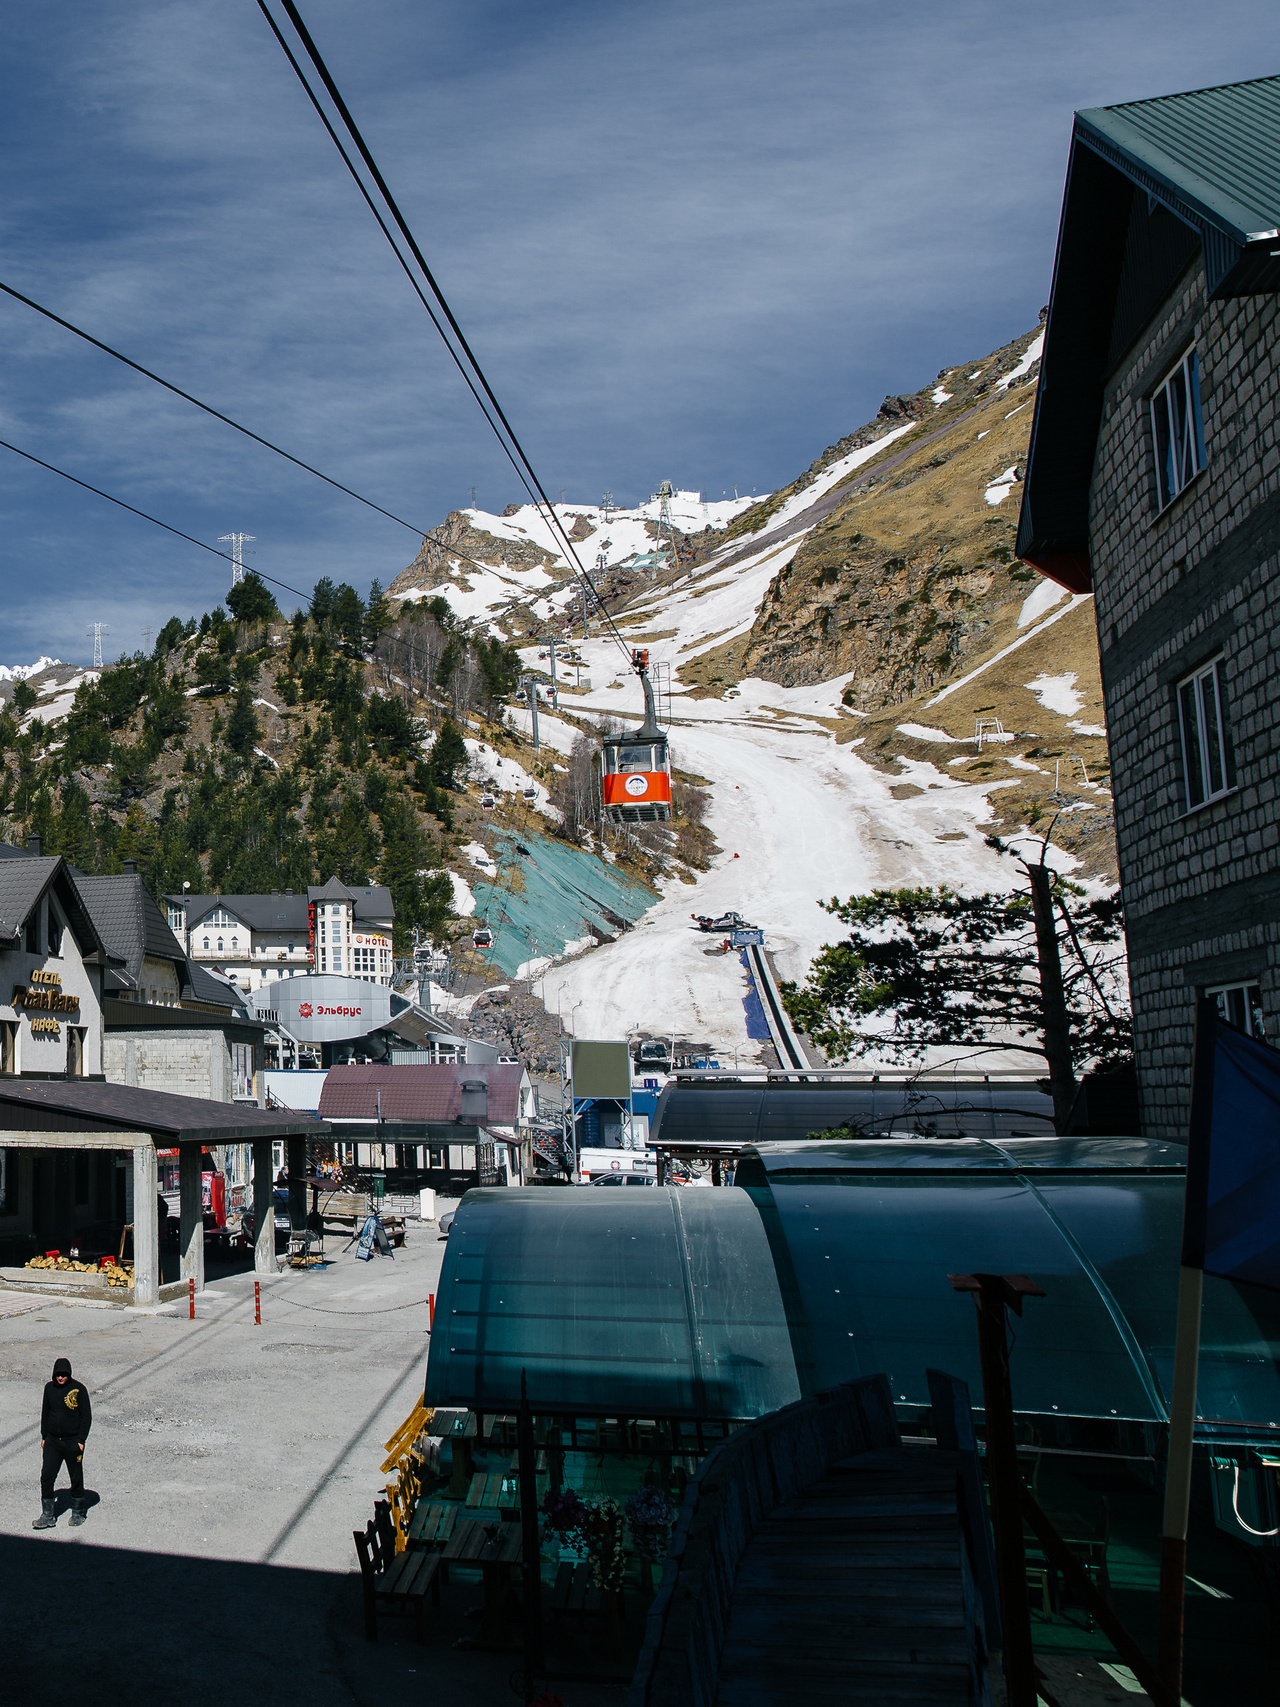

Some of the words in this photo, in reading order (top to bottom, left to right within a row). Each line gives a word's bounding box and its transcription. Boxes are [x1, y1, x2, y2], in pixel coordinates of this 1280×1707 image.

[365, 938, 389, 947] HOTEL
[31, 969, 62, 985] ОТЕЛЬ
[317, 1006, 362, 1017] Эльбрус
[30, 1018, 61, 1033] КАФЕ
